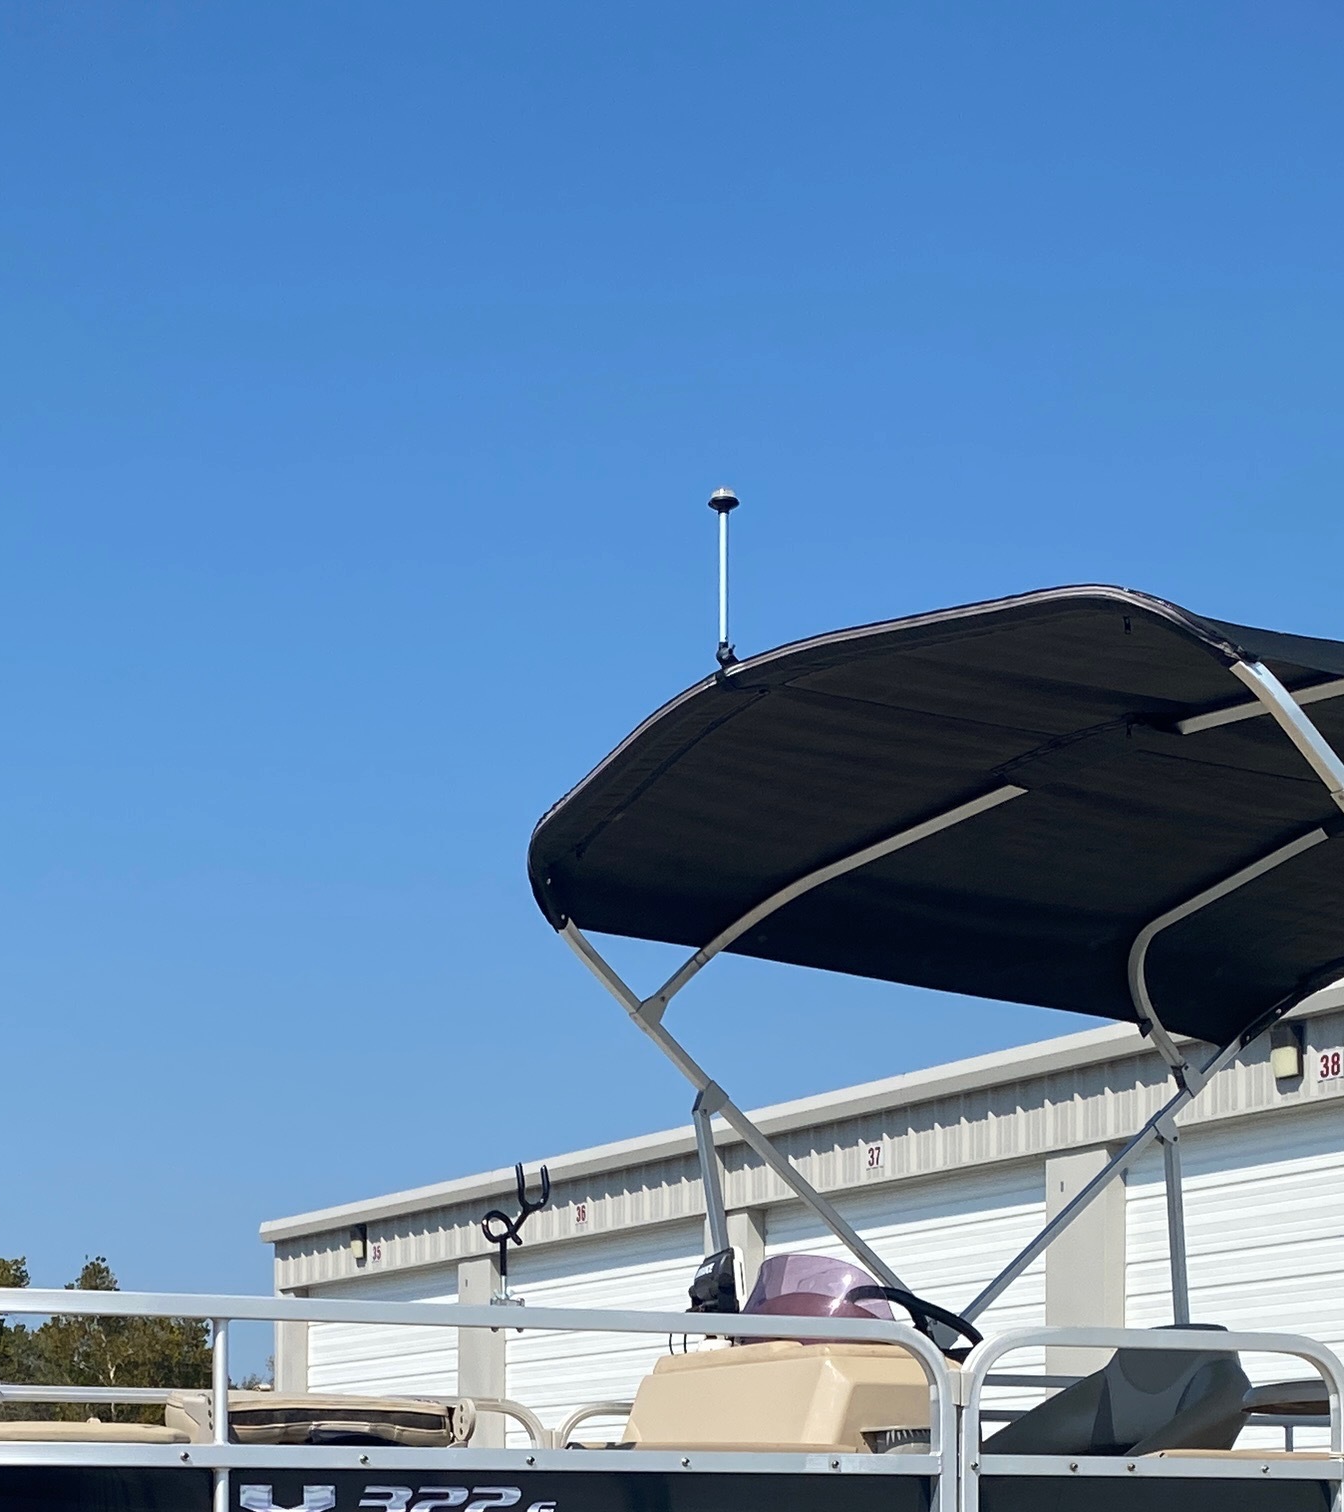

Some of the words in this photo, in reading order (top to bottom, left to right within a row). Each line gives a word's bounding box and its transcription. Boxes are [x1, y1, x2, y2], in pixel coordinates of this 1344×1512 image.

[1320, 1052, 1341, 1078] 38
[868, 1146, 881, 1167] 37
[576, 1204, 586, 1222] 36
